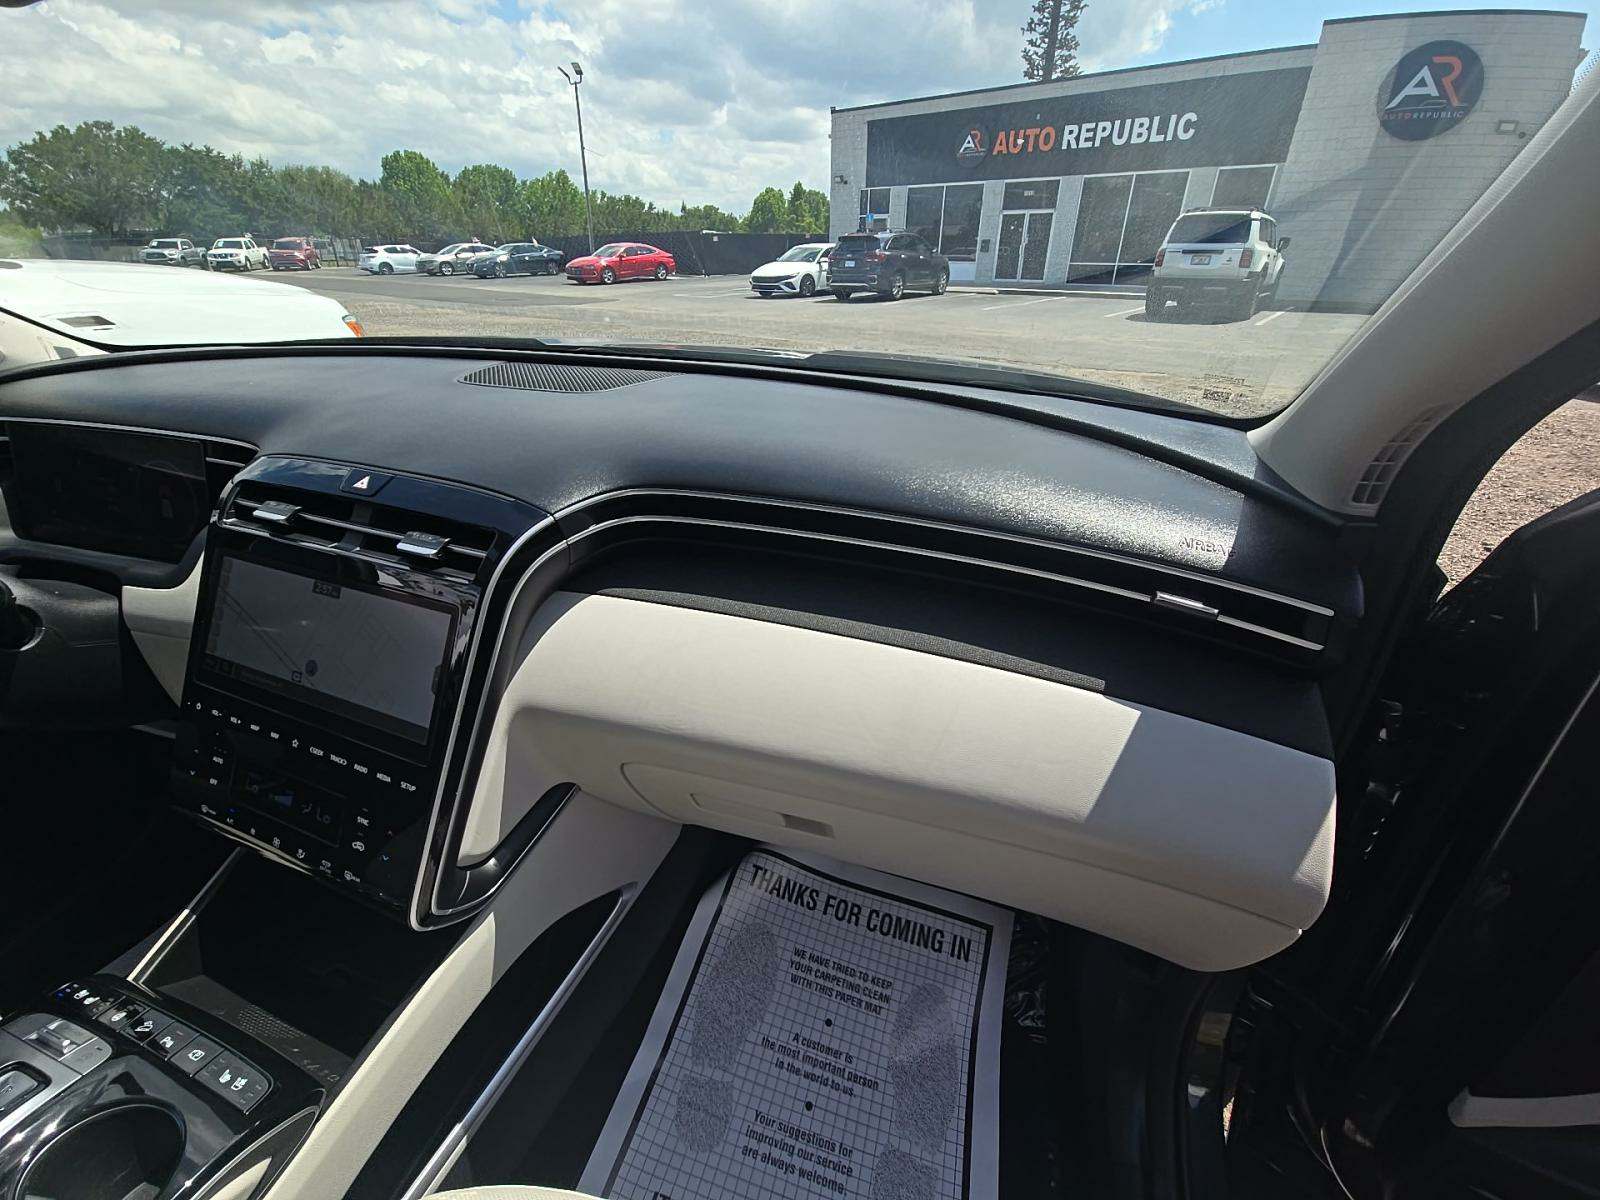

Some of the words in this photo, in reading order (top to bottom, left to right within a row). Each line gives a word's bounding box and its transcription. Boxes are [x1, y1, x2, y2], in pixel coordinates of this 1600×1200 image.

[1384, 55, 1463, 109] AR
[992, 126, 1056, 155] AUTO
[1061, 112, 1198, 150] REPUBLIC
[400, 781, 416, 792] SETUP
[750, 864, 819, 911] THANKS
[822, 894, 862, 927] FOR
[866, 909, 944, 953] COMING
[950, 934, 971, 962] IN
[790, 958, 812, 976] YOUR
[814, 968, 861, 993] CARPETING
[863, 987, 890, 1004] CLEAN
[793, 947, 807, 960] WE
[808, 952, 830, 968] HAVE
[832, 960, 855, 978] TRIED
[858, 970, 869, 983] TO
[870, 974, 892, 990] KEEP
[790, 972, 813, 989] WITH
[814, 982, 833, 998] THIS
[834, 990, 864, 1008] PAPER
[864, 1001, 882, 1016] MAT
[761, 1036, 776, 1050] the
[777, 1043, 800, 1059] most
[802, 1053, 846, 1079] important
[847, 1071, 879, 1091] person
[792, 1033, 799, 1044] A
[801, 1037, 843, 1060] customer
[844, 1052, 854, 1064] is
[786, 1062, 801, 1076] the
[803, 1071, 829, 1087] world
[830, 1080, 841, 1092] to
[745, 1124, 795, 1157] improving
[797, 1147, 815, 1162] our
[815, 1155, 854, 1177] service
[754, 1109, 776, 1129] Your
[777, 1121, 837, 1152] suggestions
[838, 1142, 854, 1158] for
[741, 1145, 759, 1160] are
[760, 1152, 797, 1175] always
